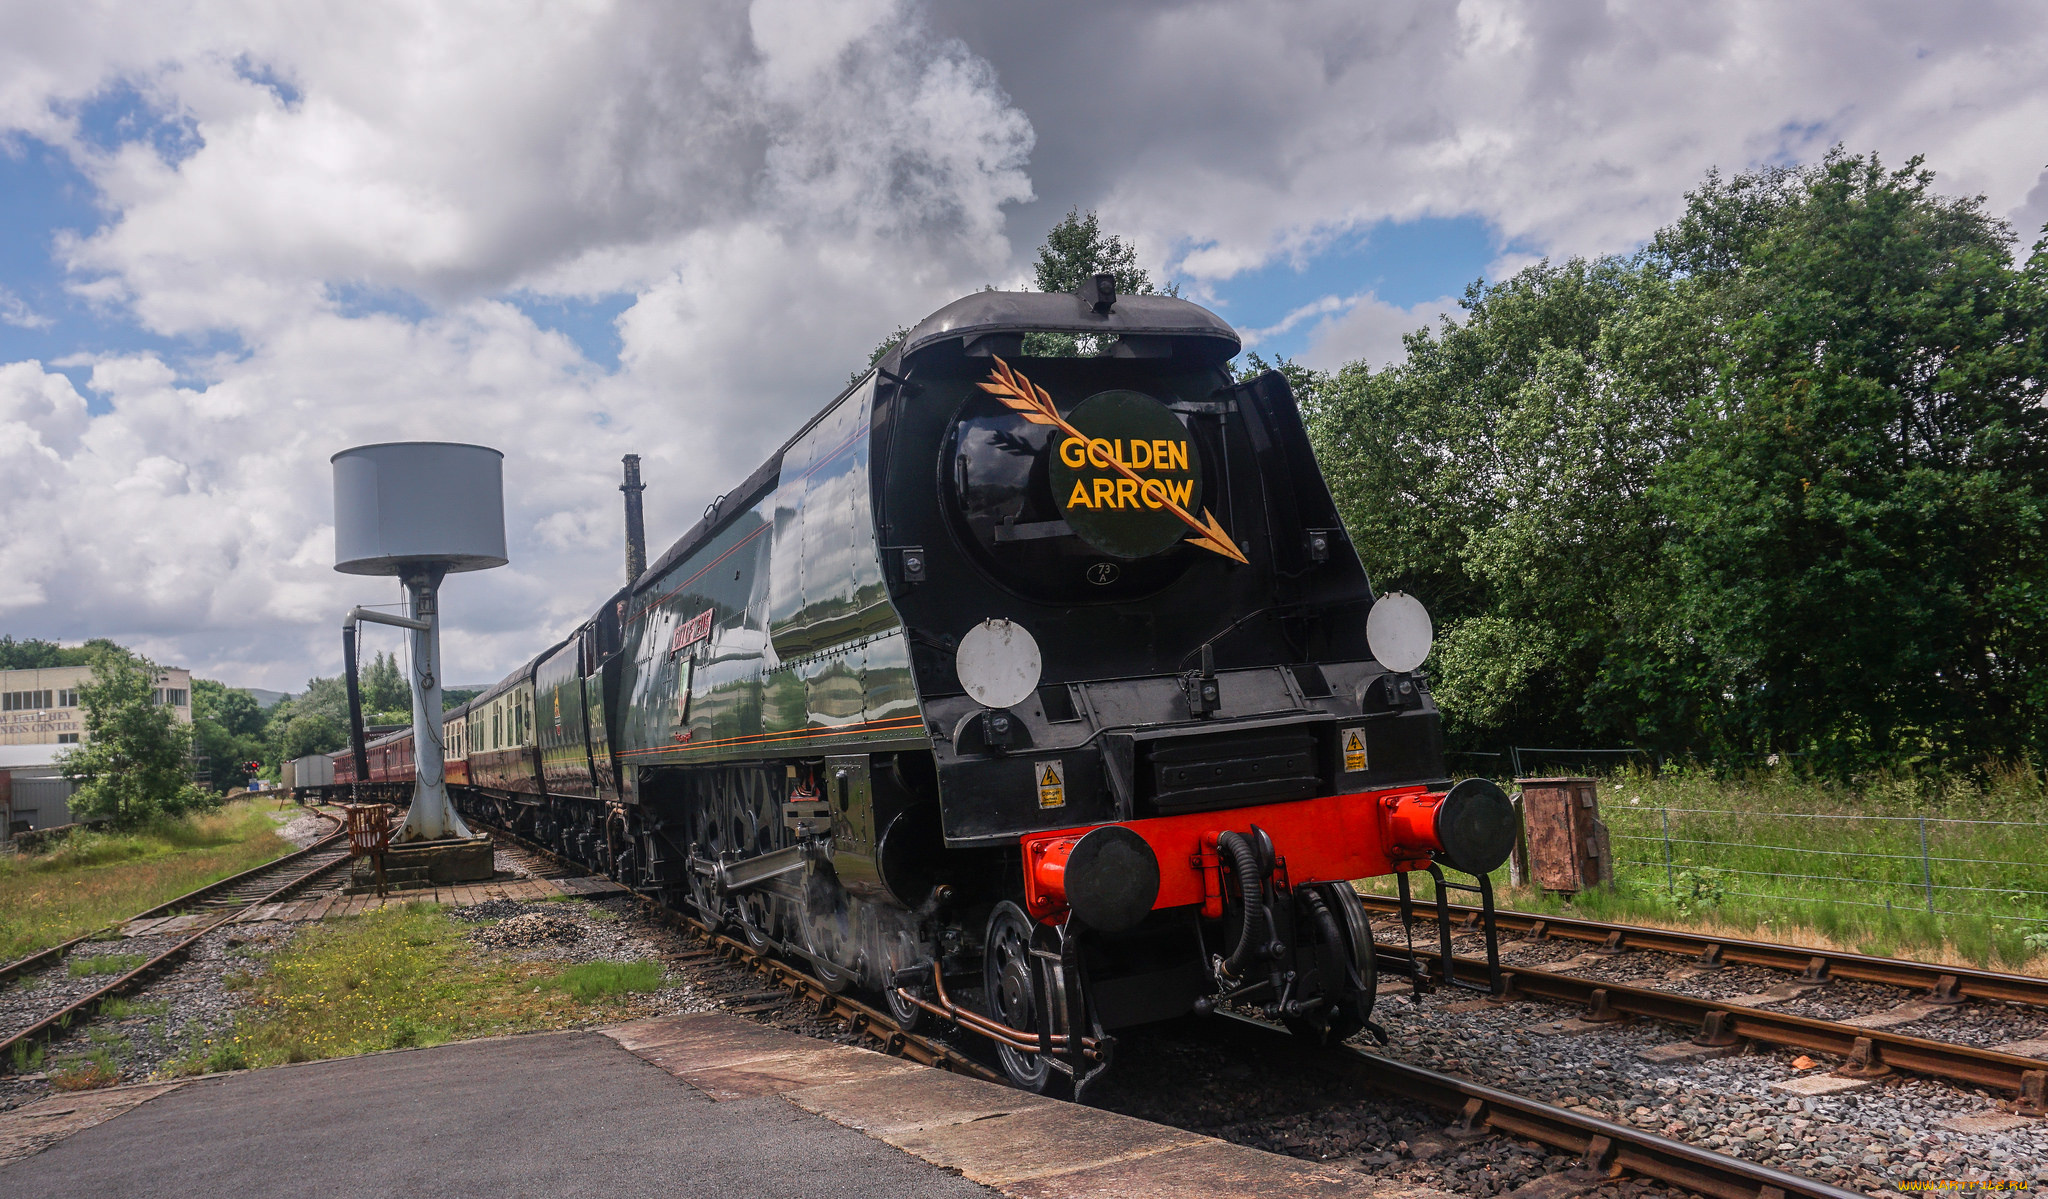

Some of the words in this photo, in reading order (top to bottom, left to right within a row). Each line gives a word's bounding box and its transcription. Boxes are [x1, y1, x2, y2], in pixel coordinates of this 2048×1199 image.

[1059, 437, 1189, 470] GOLDEN
[1066, 478, 1194, 509] ARROW
[1098, 564, 1111, 575] 73
[1099, 573, 1107, 582] A
[48, 711, 72, 721] HEY
[31, 721, 80, 733] CENTRE
